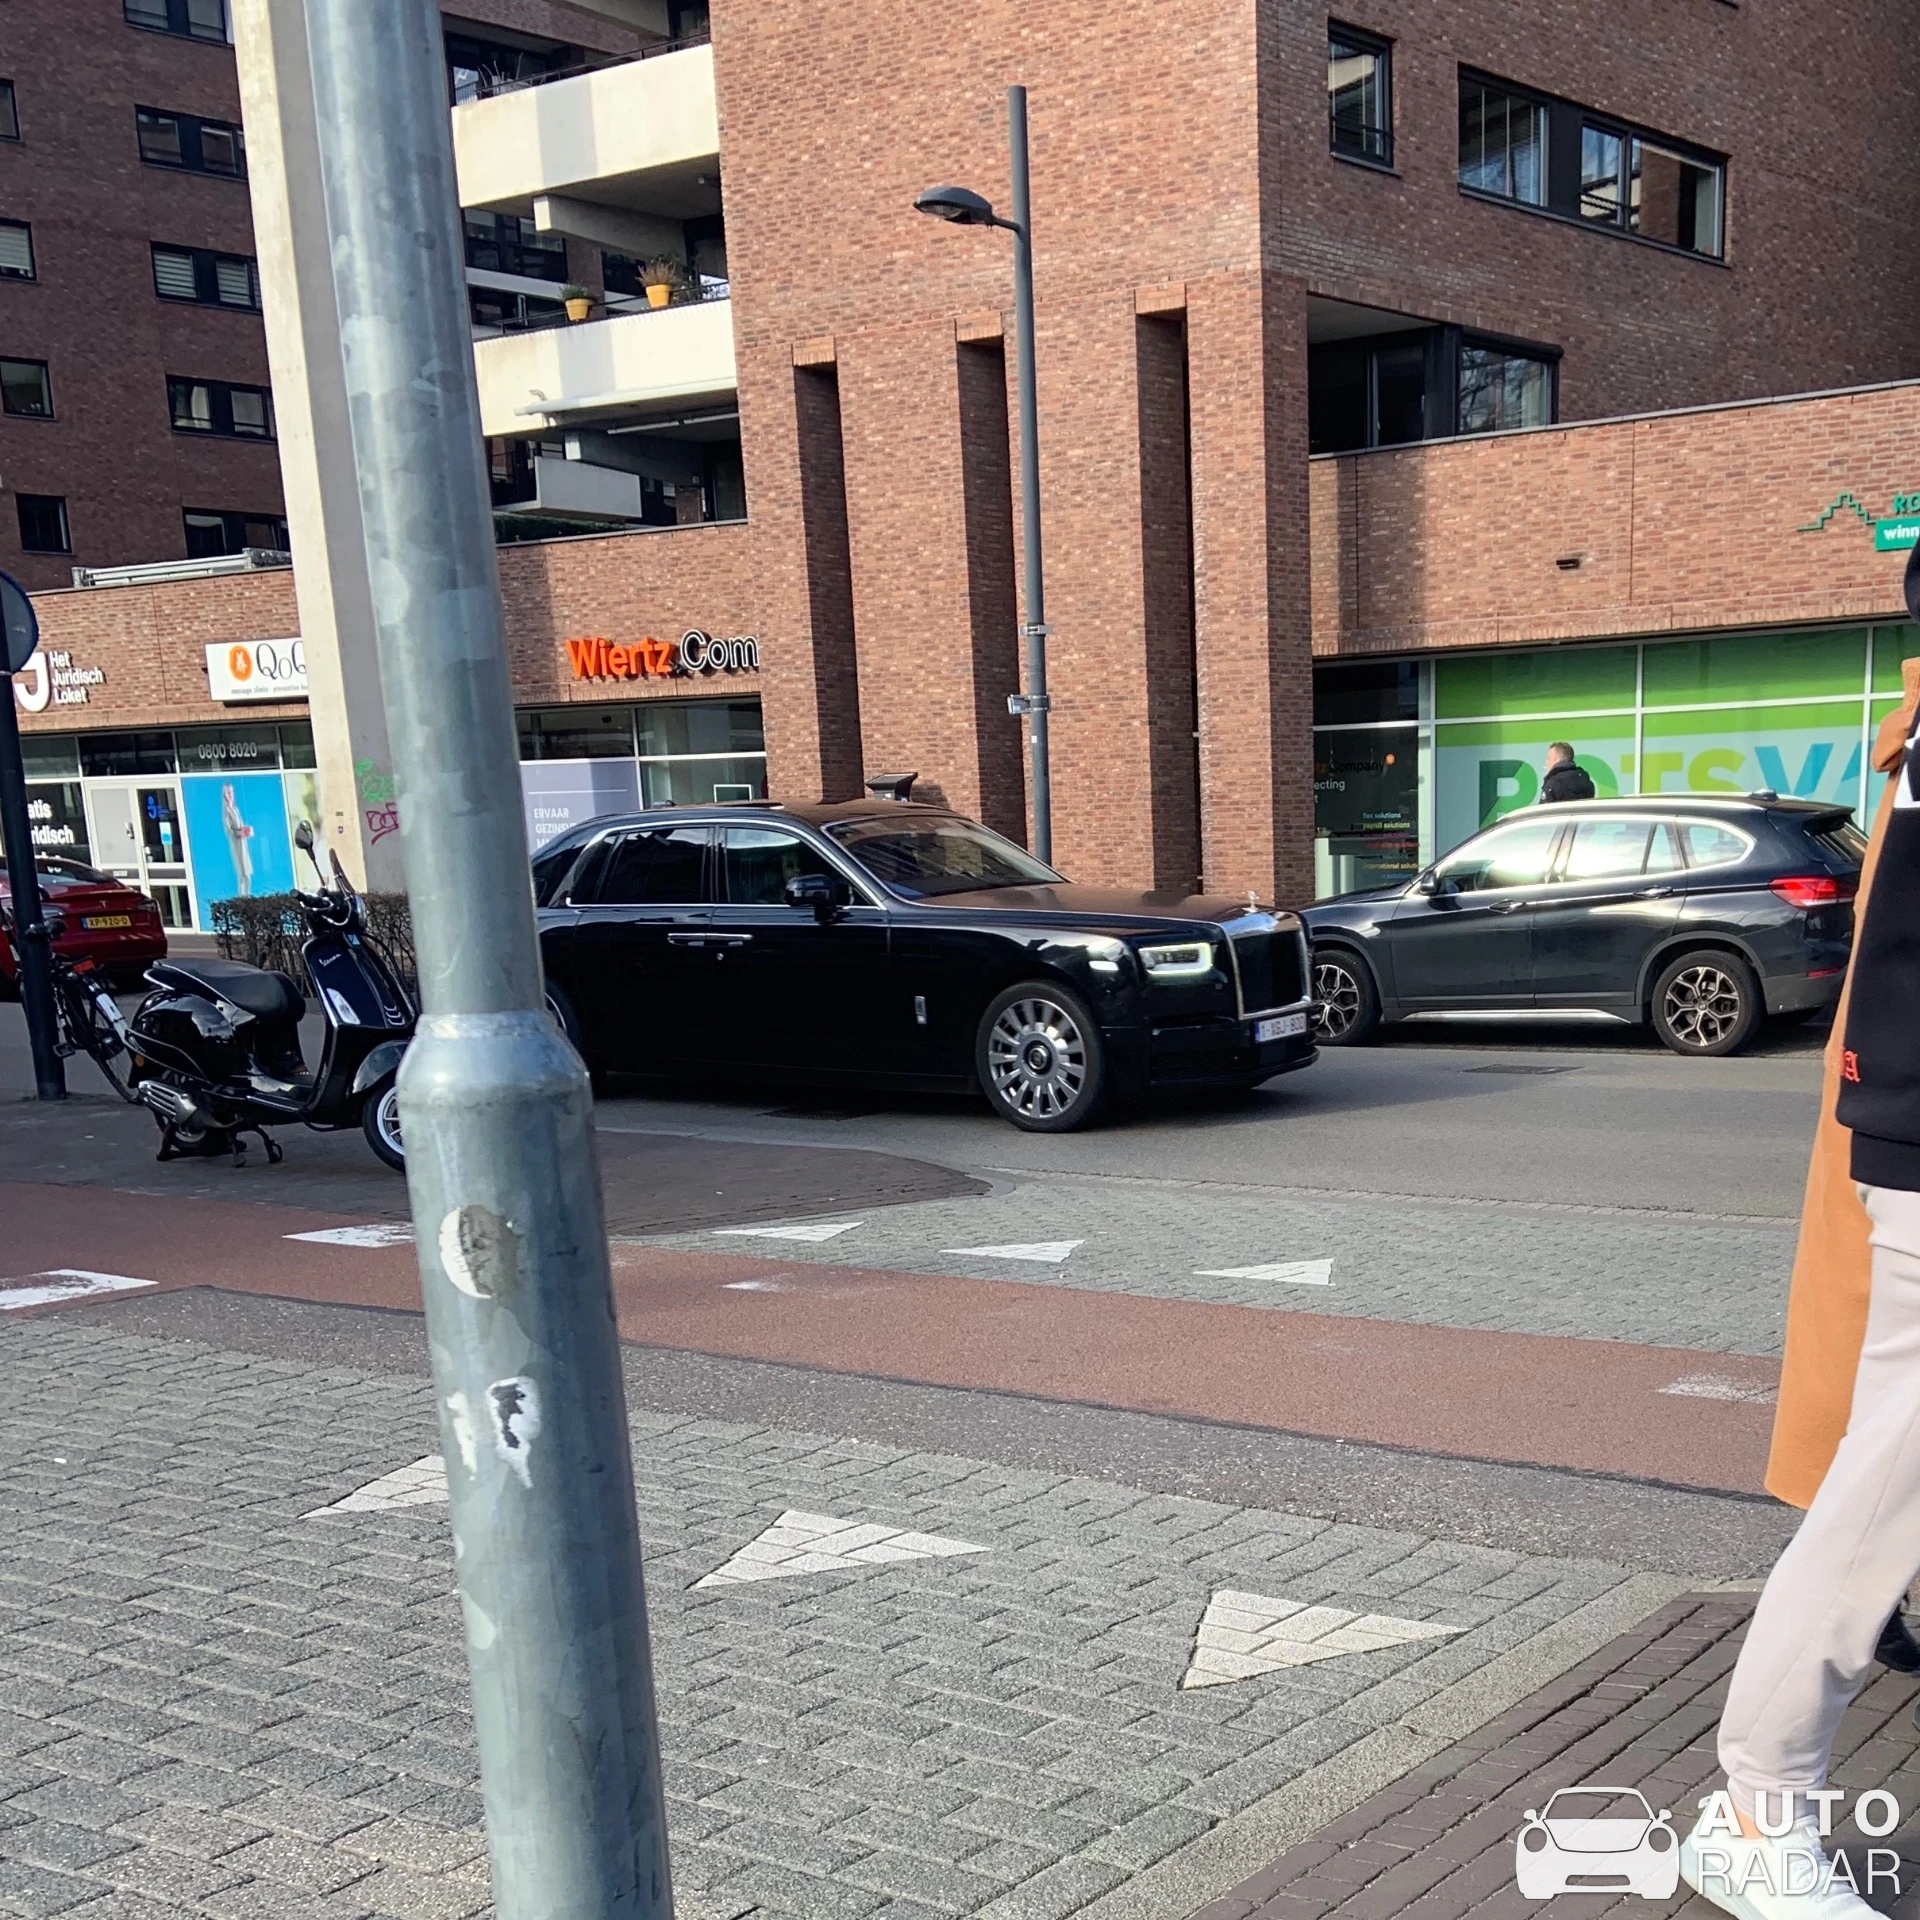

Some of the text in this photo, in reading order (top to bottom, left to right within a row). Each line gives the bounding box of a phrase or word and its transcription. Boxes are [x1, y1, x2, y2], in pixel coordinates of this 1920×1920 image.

[49, 651, 72, 668] Het
[565, 637, 672, 681] Wiertz
[52, 666, 105, 686] Juridisch
[53, 686, 88, 704] Loket
[198, 742, 257, 759] 0800 8020
[533, 807, 570, 819] ERVAAR
